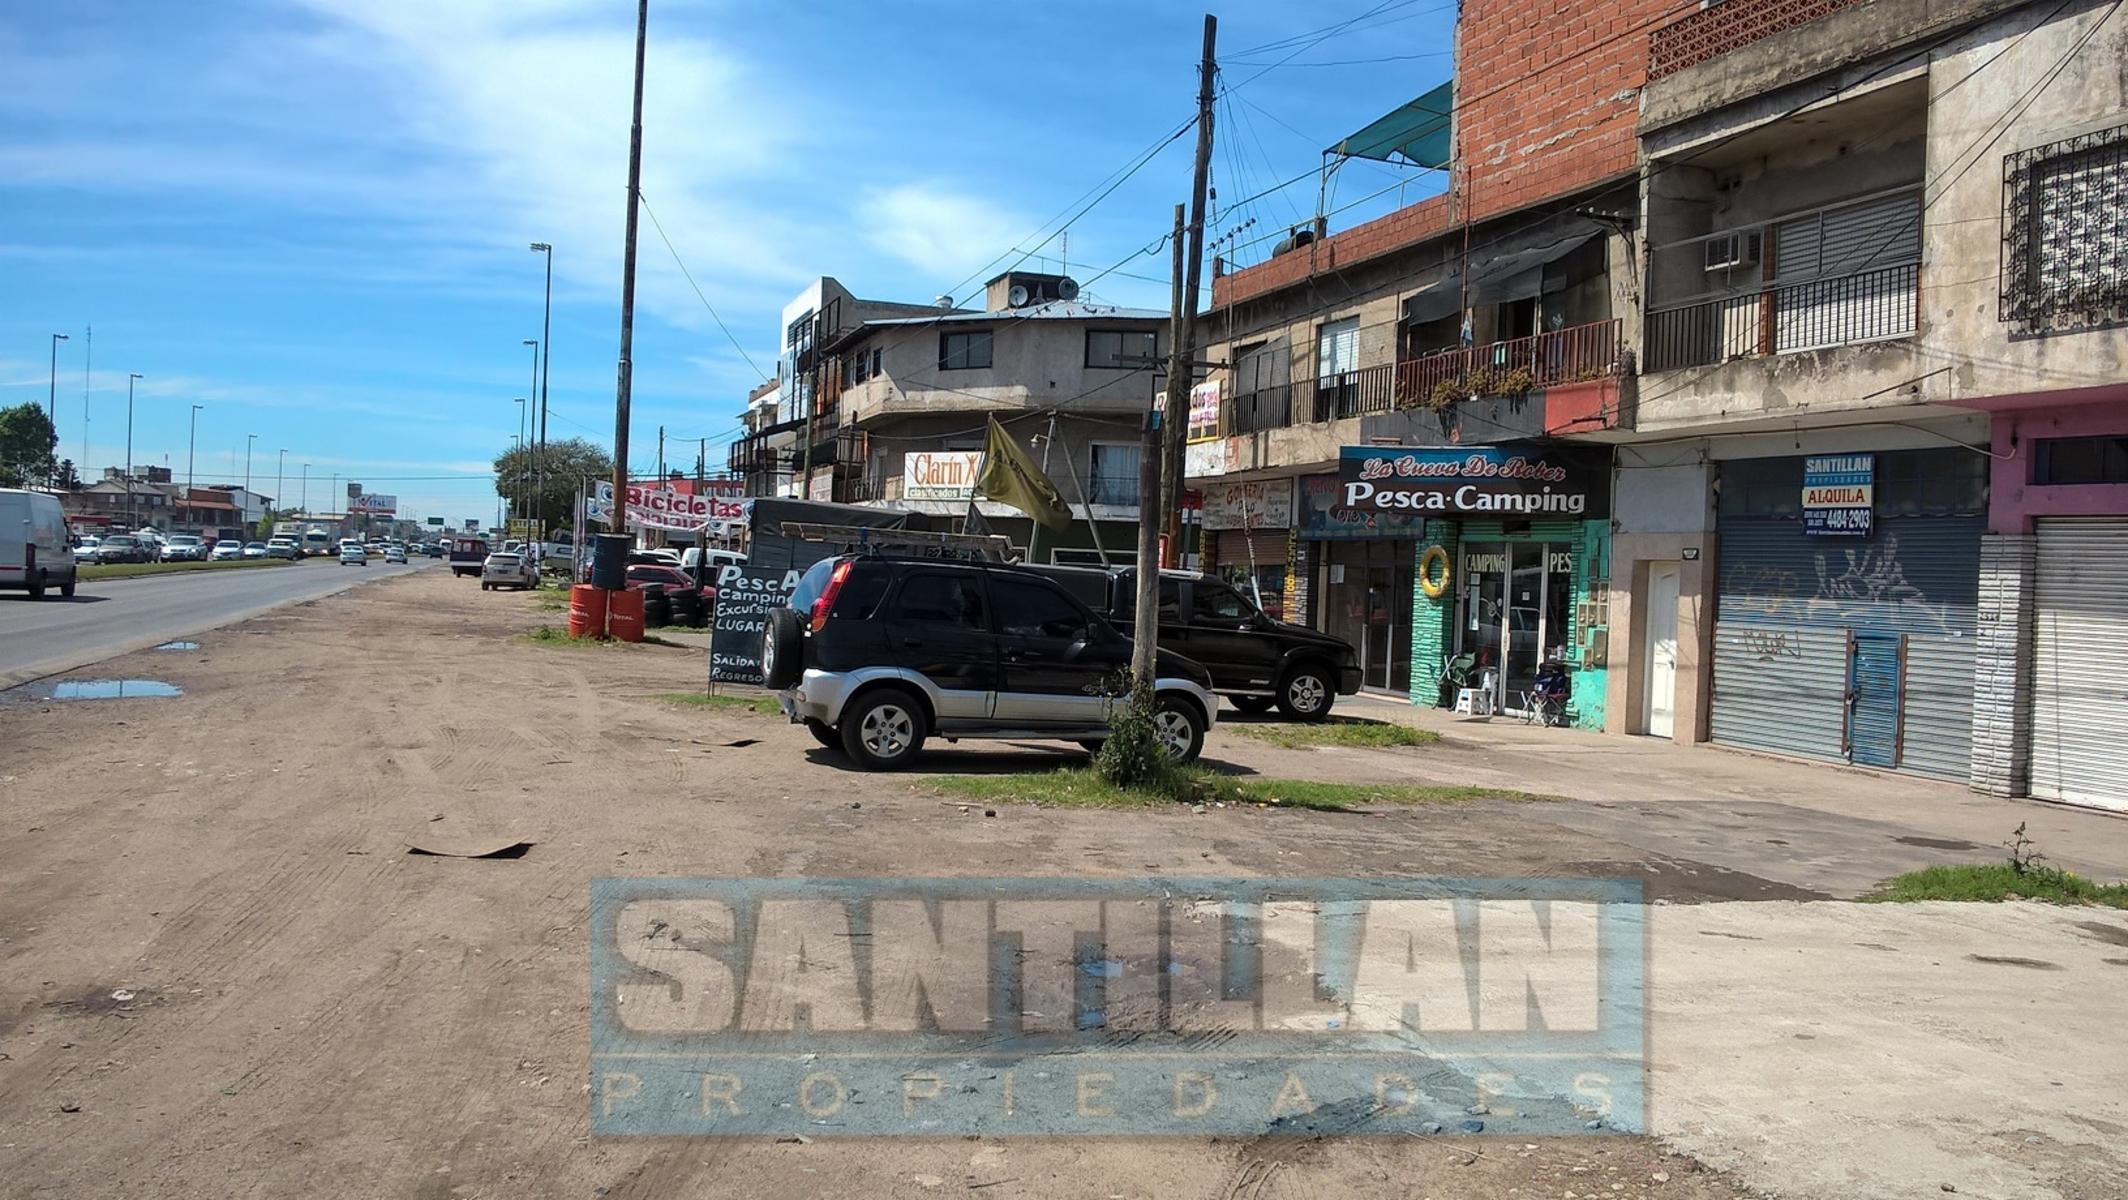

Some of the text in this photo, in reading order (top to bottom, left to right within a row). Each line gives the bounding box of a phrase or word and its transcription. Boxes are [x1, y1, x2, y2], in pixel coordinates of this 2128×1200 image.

[1359, 455, 1566, 481] La Cueva De Rober
[1806, 457, 1872, 473] SANTILLAN
[908, 487, 958, 499] clasificados
[1807, 488, 1866, 504] ALQUILA
[625, 488, 742, 518] Bicicletas
[1827, 509, 1871, 529] 4484-2903
[1465, 554, 1505, 573] CAMPING
